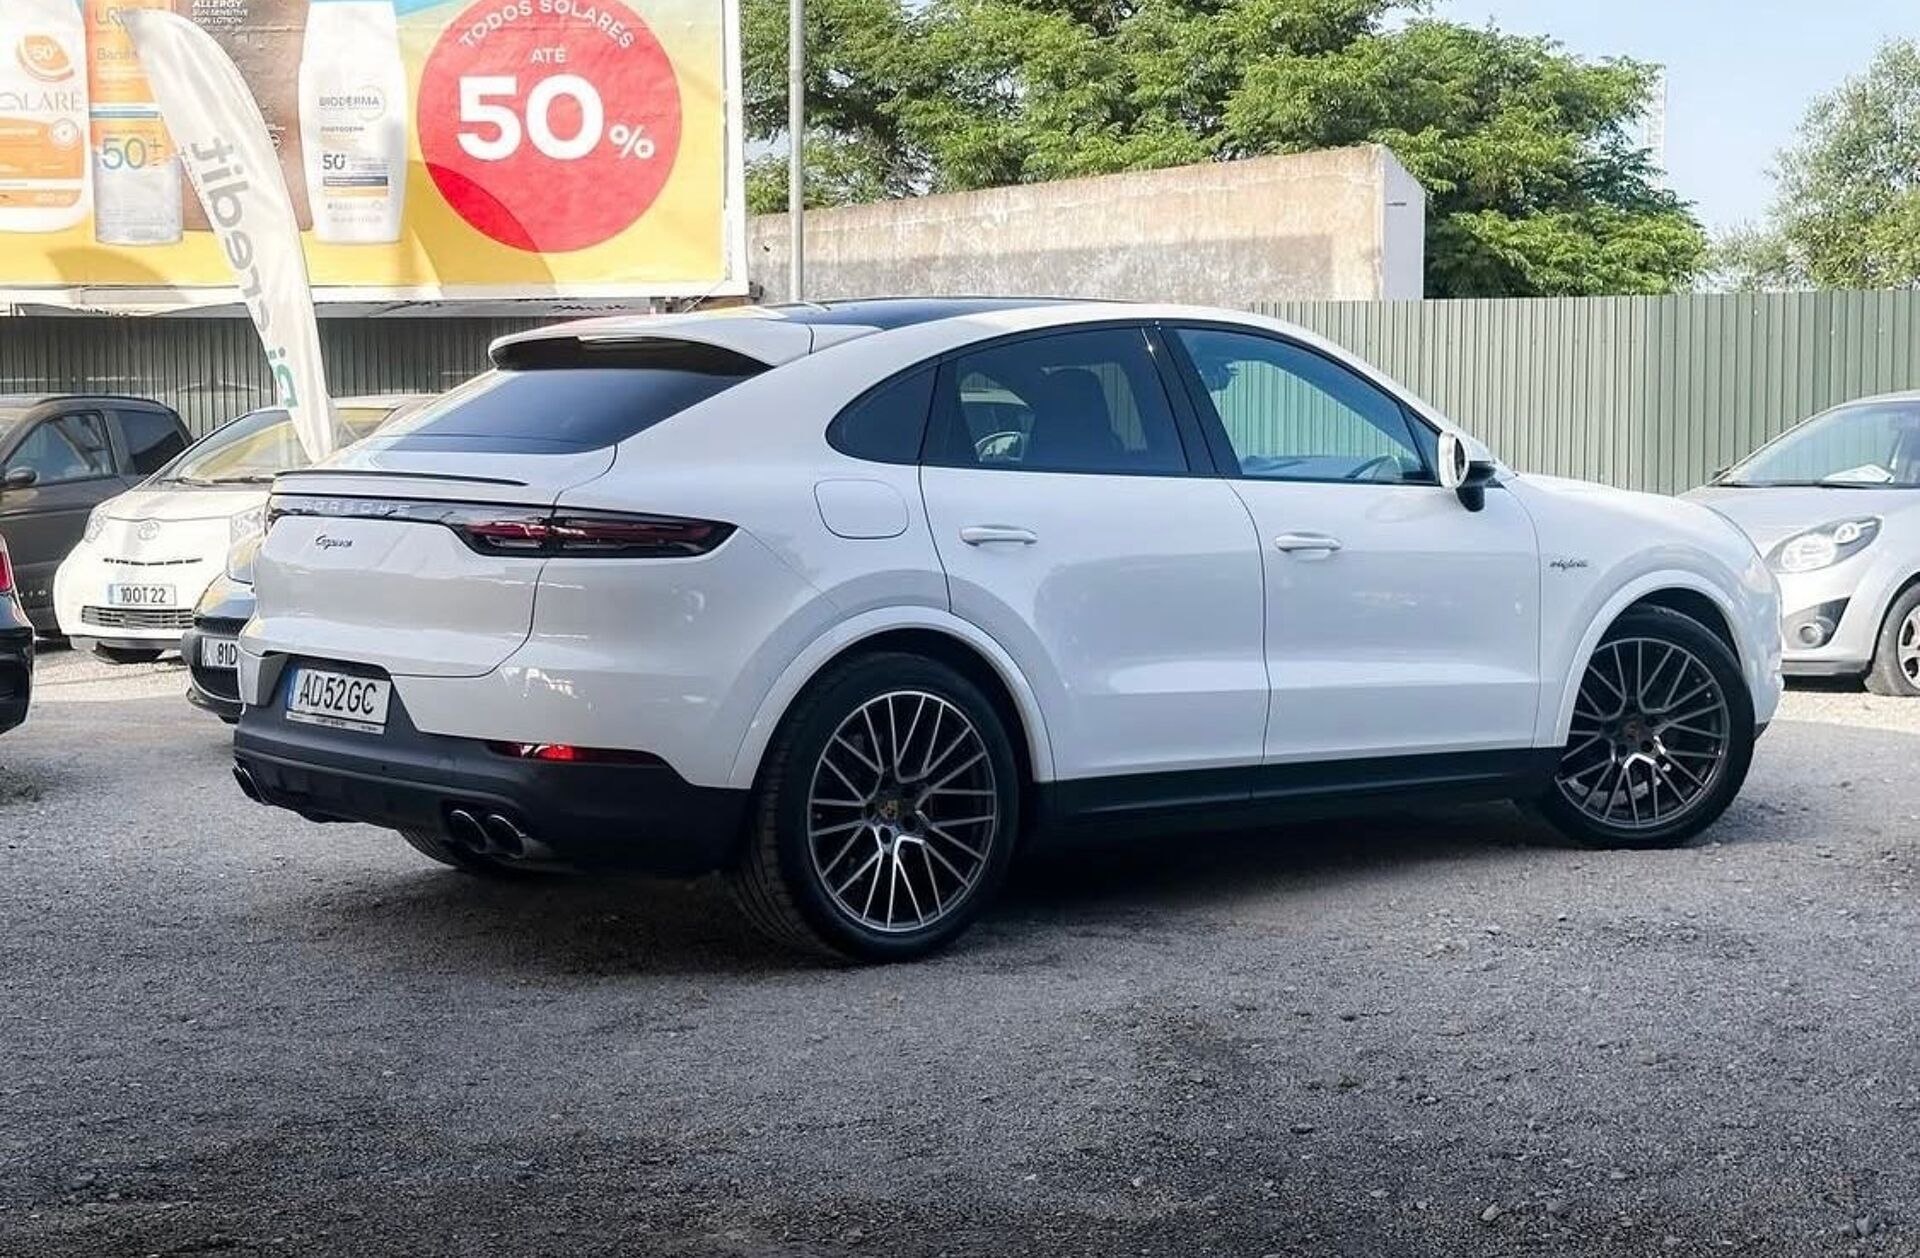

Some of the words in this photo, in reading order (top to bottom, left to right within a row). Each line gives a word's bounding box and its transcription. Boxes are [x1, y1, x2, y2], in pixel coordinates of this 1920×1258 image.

[459, 0, 533, 47] TODOS
[539, 0, 634, 48] SOLARES
[319, 96, 380, 107] BIODERMA
